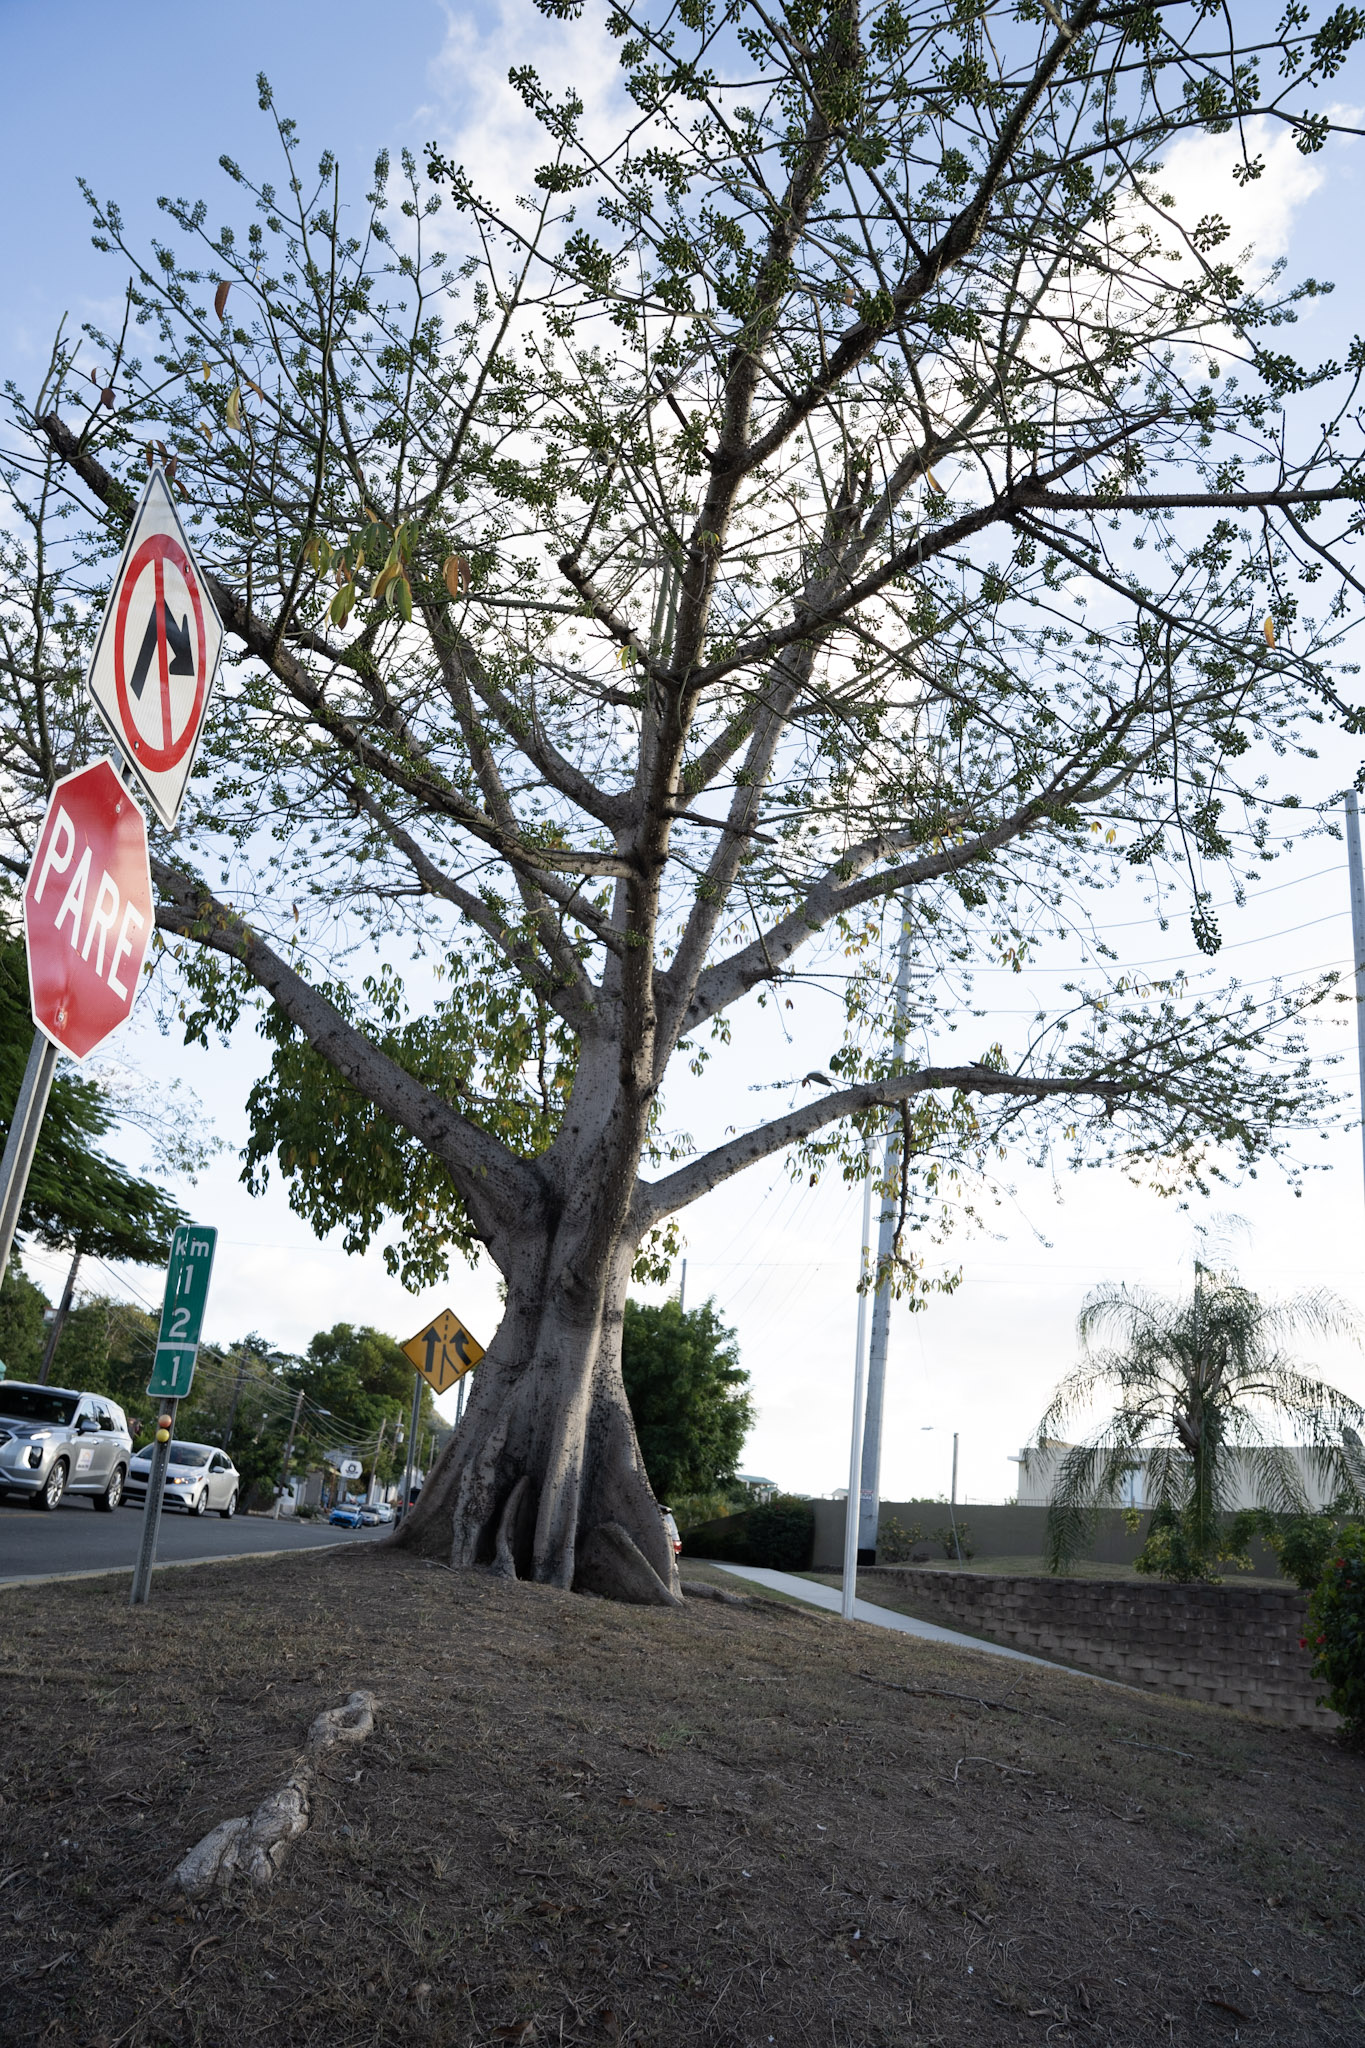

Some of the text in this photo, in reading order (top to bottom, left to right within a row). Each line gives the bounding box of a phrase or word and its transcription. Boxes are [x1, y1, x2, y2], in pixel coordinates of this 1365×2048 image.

[34, 805, 144, 1002] PARE
[184, 1264, 194, 1294] 1
[168, 1307, 191, 1338] 2
